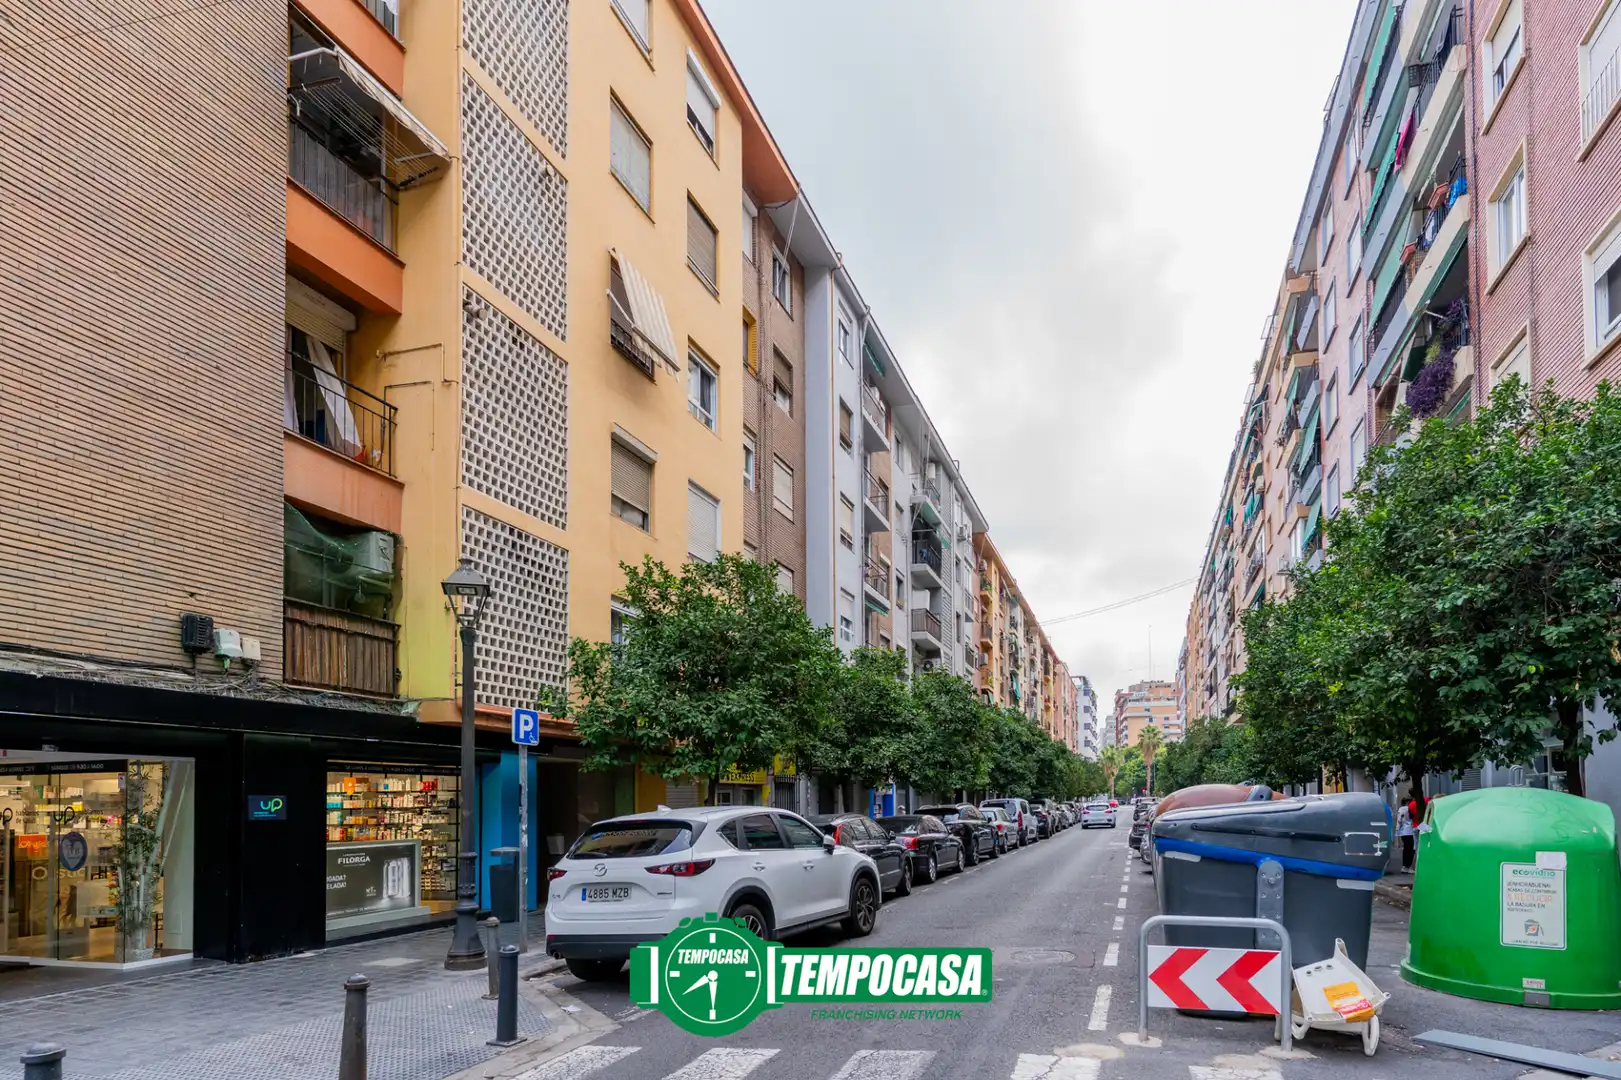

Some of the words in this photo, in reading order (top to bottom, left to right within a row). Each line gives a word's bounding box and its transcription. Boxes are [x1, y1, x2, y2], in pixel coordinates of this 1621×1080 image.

[519, 713, 534, 739] P
[260, 798, 283, 812] up
[337, 856, 371, 864] FILORGA
[588, 888, 609, 899] 4885
[612, 887, 629, 898] MZB
